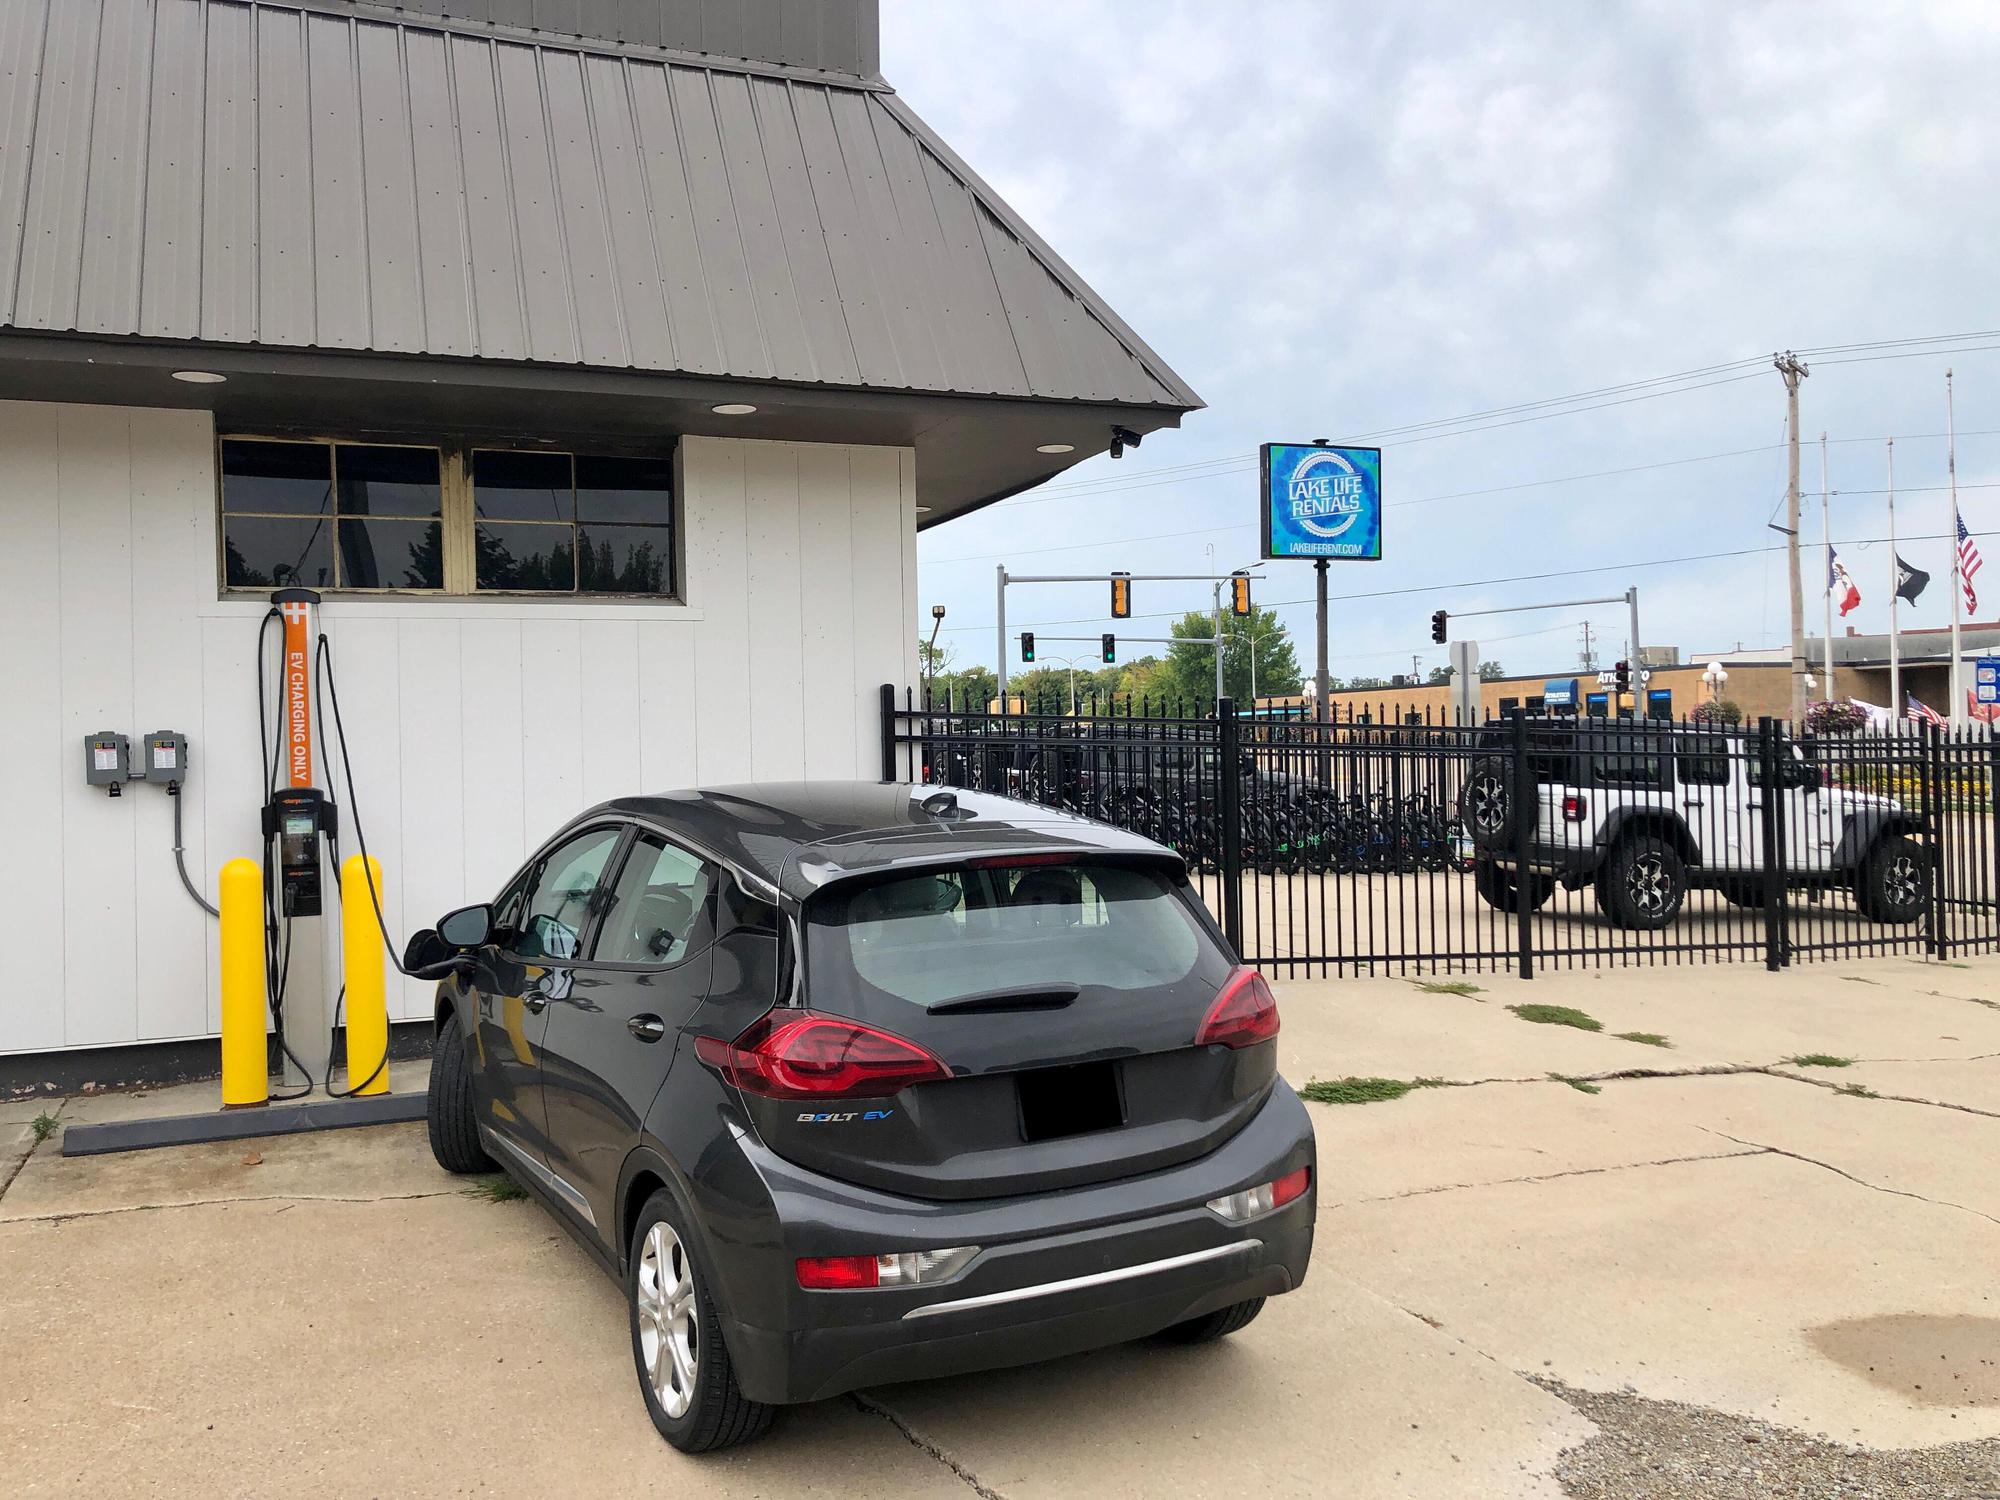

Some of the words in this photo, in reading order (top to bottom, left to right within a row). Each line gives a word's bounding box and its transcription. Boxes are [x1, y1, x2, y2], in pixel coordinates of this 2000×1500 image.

[1288, 479, 1330, 500] LAKE
[1334, 476, 1362, 495] LIFE
[1292, 494, 1360, 518] RENTALS
[1290, 542, 1362, 555] LAKELIFERENT.COM
[291, 652, 303, 669] EV
[291, 672, 306, 743] CHARGING
[294, 746, 307, 781] ONLY
[796, 1112, 859, 1122] BOLT
[863, 1110, 894, 1120] EV
